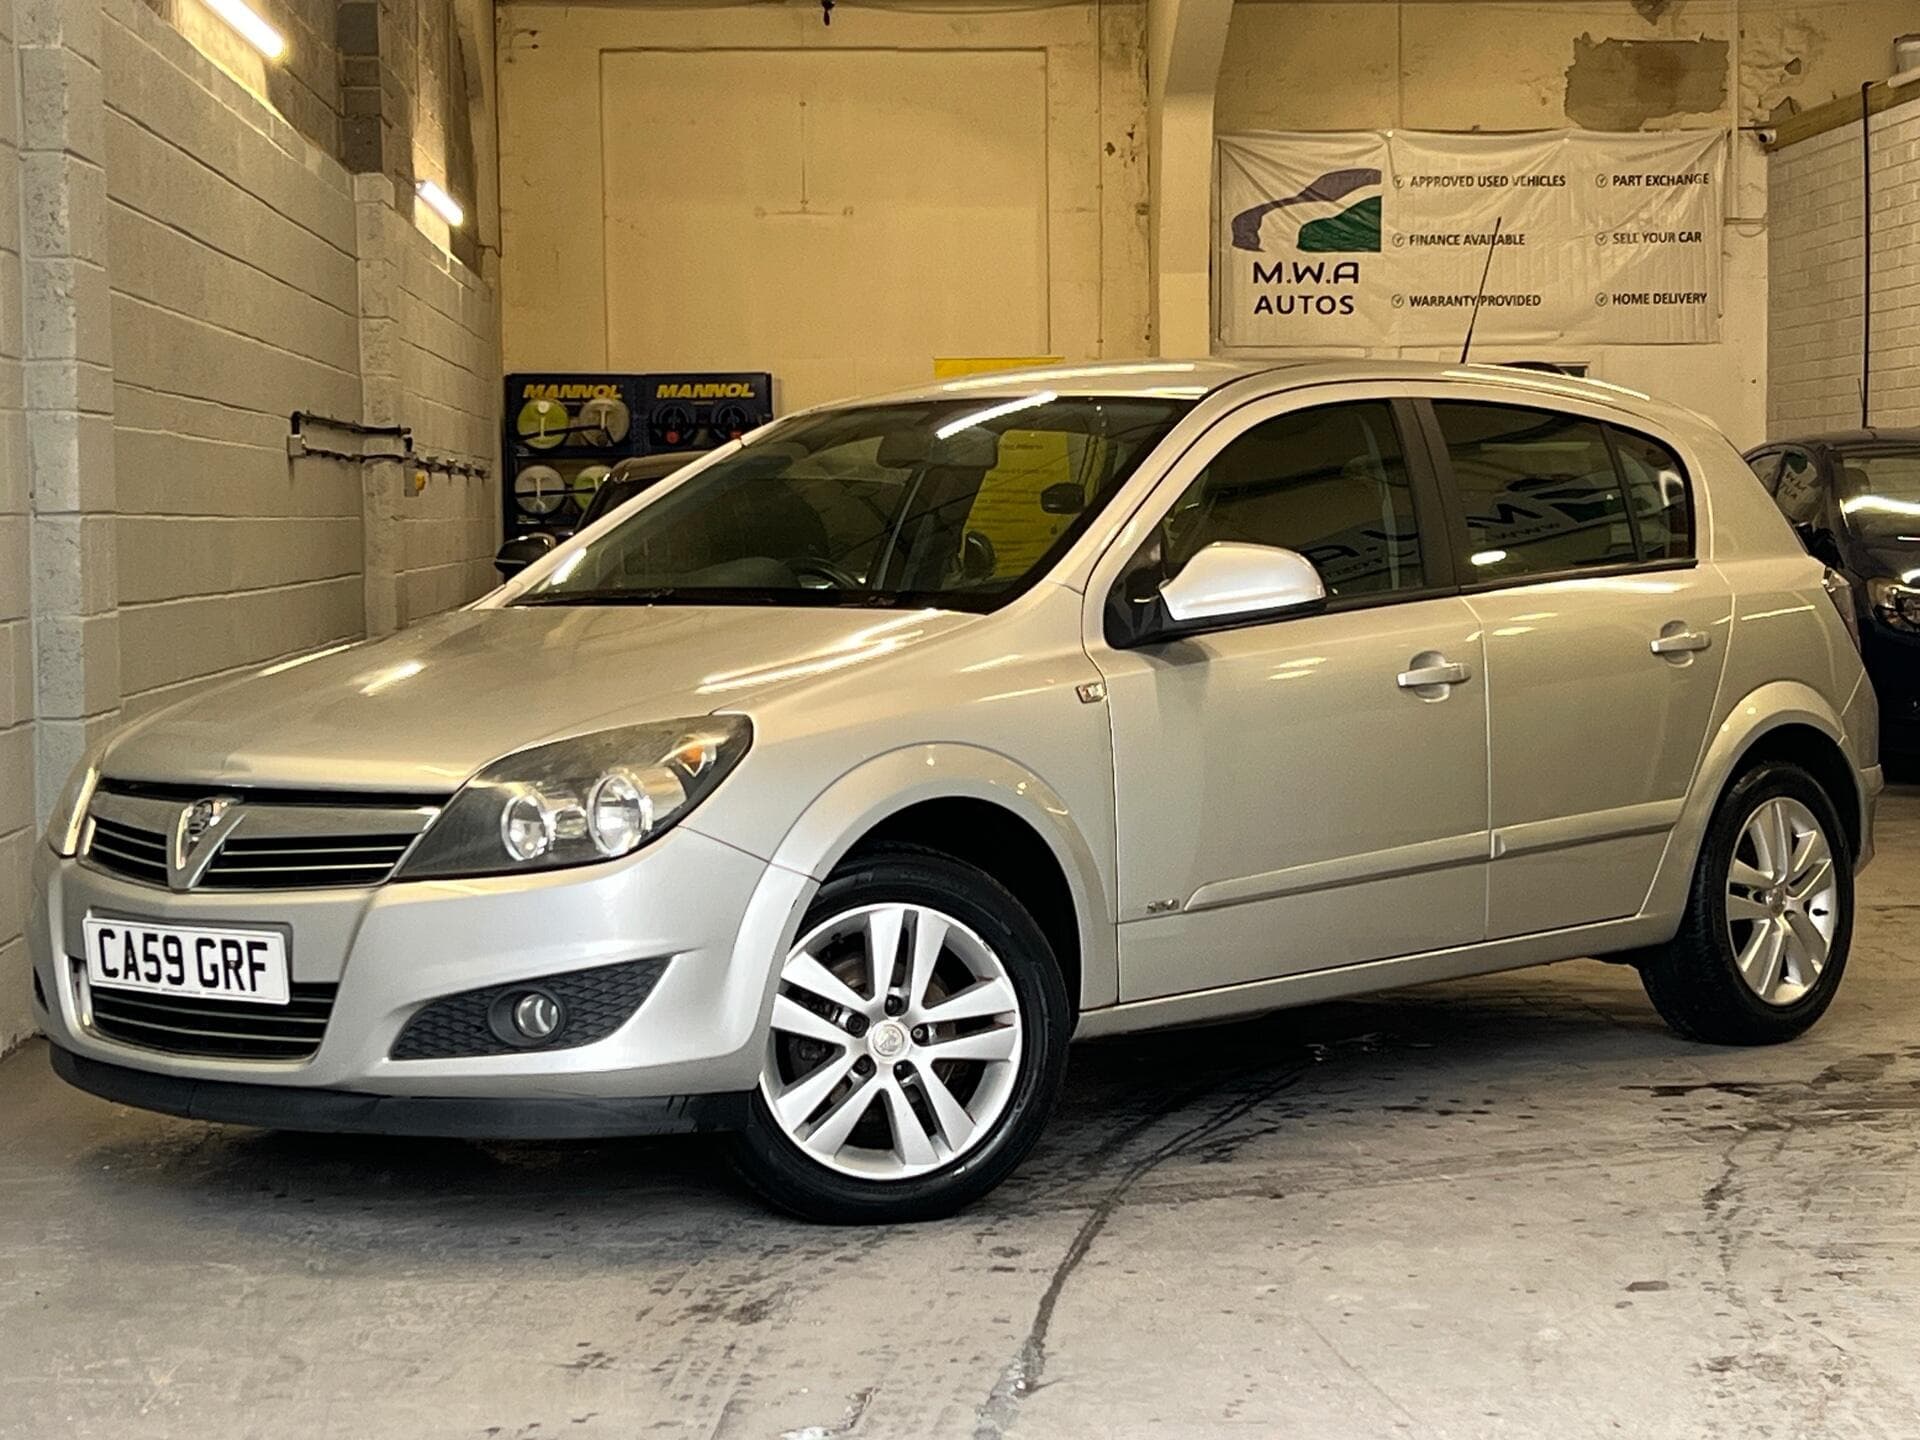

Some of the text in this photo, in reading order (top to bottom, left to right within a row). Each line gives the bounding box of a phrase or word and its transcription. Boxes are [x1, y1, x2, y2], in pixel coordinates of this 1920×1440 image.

[1410, 174, 1566, 188] APPROVED USED VEHICLES
[1612, 173, 1710, 187] PART EXCHANGE
[1409, 234, 1460, 246] FINANCE
[1612, 231, 1702, 244] SELL YOUR CAR
[1253, 262, 1359, 284] M.W.A
[1254, 295, 1354, 315] AUTOS
[1409, 295, 1542, 307] WARRANTY PROVIDED
[1612, 292, 1708, 305] HOME DELIVERY
[523, 384, 622, 399] MANNOL
[656, 383, 755, 398] MANNOL
[98, 928, 268, 992] CA59 GRF
